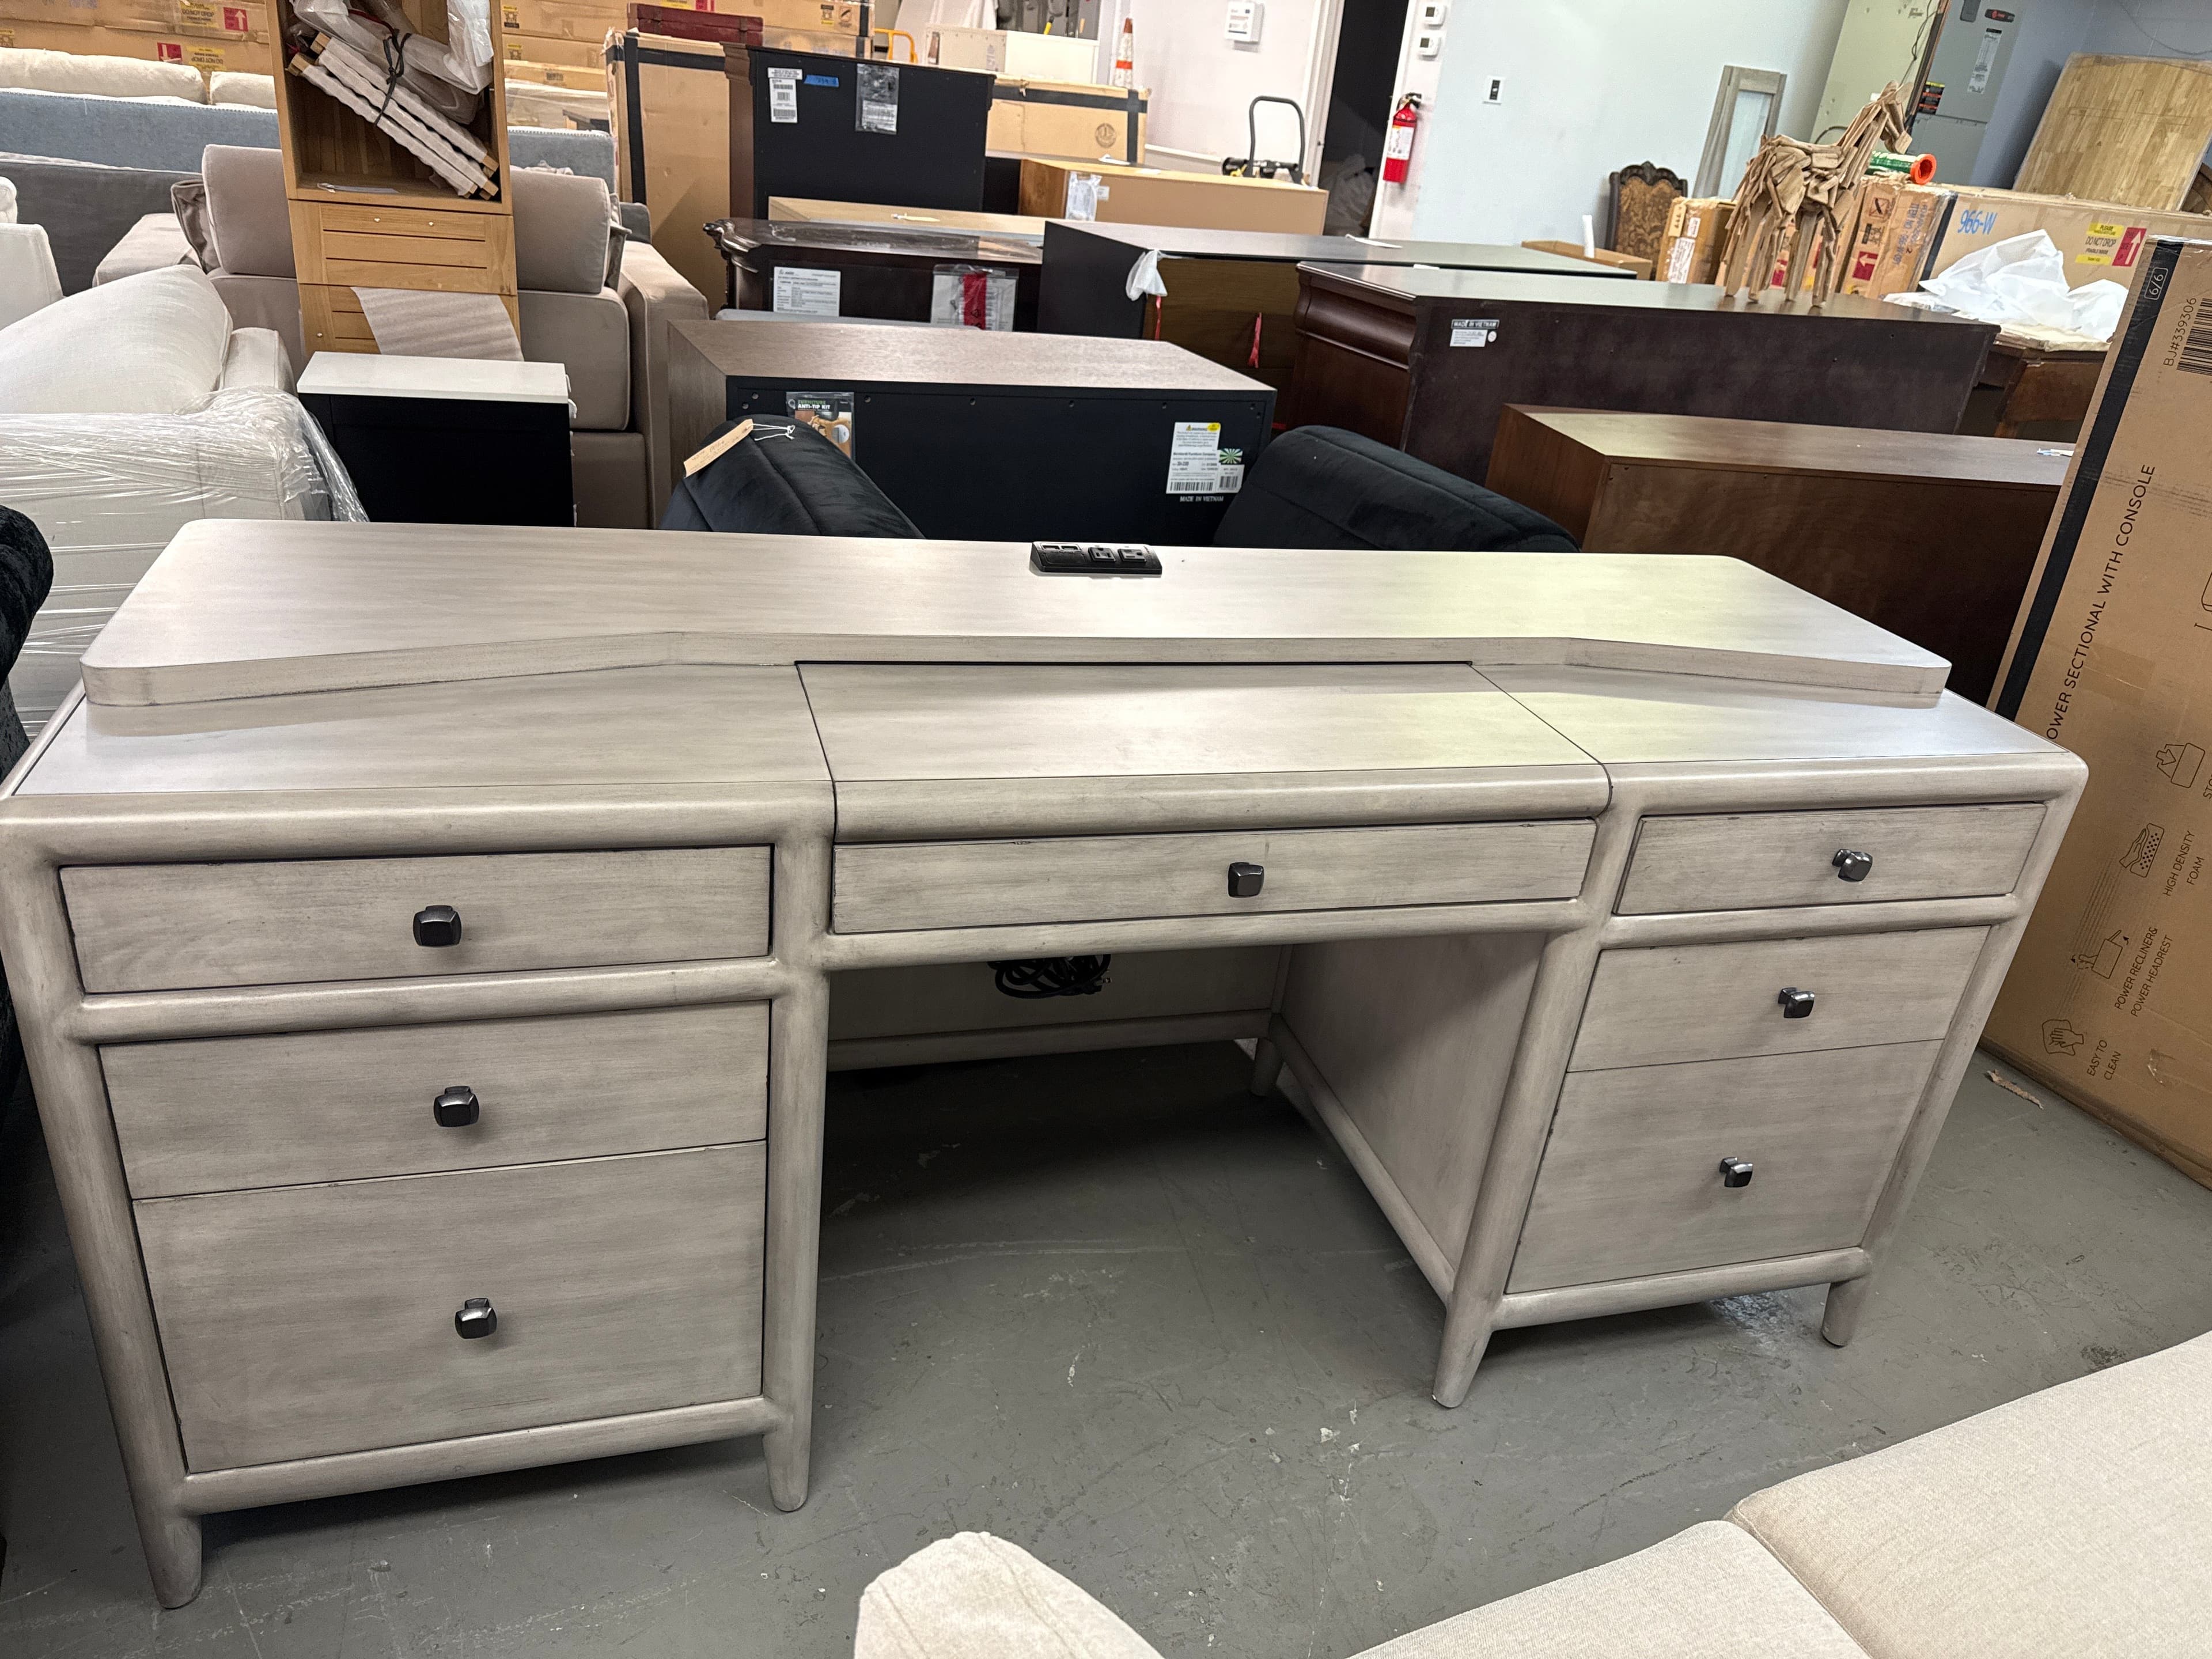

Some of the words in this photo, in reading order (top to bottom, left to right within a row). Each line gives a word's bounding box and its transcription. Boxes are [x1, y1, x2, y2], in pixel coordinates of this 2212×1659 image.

[1957, 209, 1998, 235] 966-W
[2085, 236, 2094, 245] DO
[2094, 237, 2103, 246] NOT
[2102, 238, 2116, 248] DROP
[2149, 274, 2164, 296] 6/6
[2163, 297, 2197, 366] BJ#339306
[2046, 692, 2072, 740] OWER
[2064, 601, 2107, 689] SECTIONAL
[2097, 551, 2123, 594] WITH
[2116, 464, 2156, 547] CONSOLE
[2162, 871, 2179, 897] HIGH
[2172, 830, 2195, 872] DENSITY
[2186, 856, 2205, 886] FOAM
[2114, 976, 2135, 1010] POWER
[2130, 926, 2158, 976] RECLINER&
[2130, 983, 2152, 1018] POWER
[2146, 934, 2173, 983] HEADREST
[2086, 1052, 2104, 1077] EASY
[2096, 1040, 2107, 1052] TO
[2104, 1051, 2122, 1081] CLEAN
